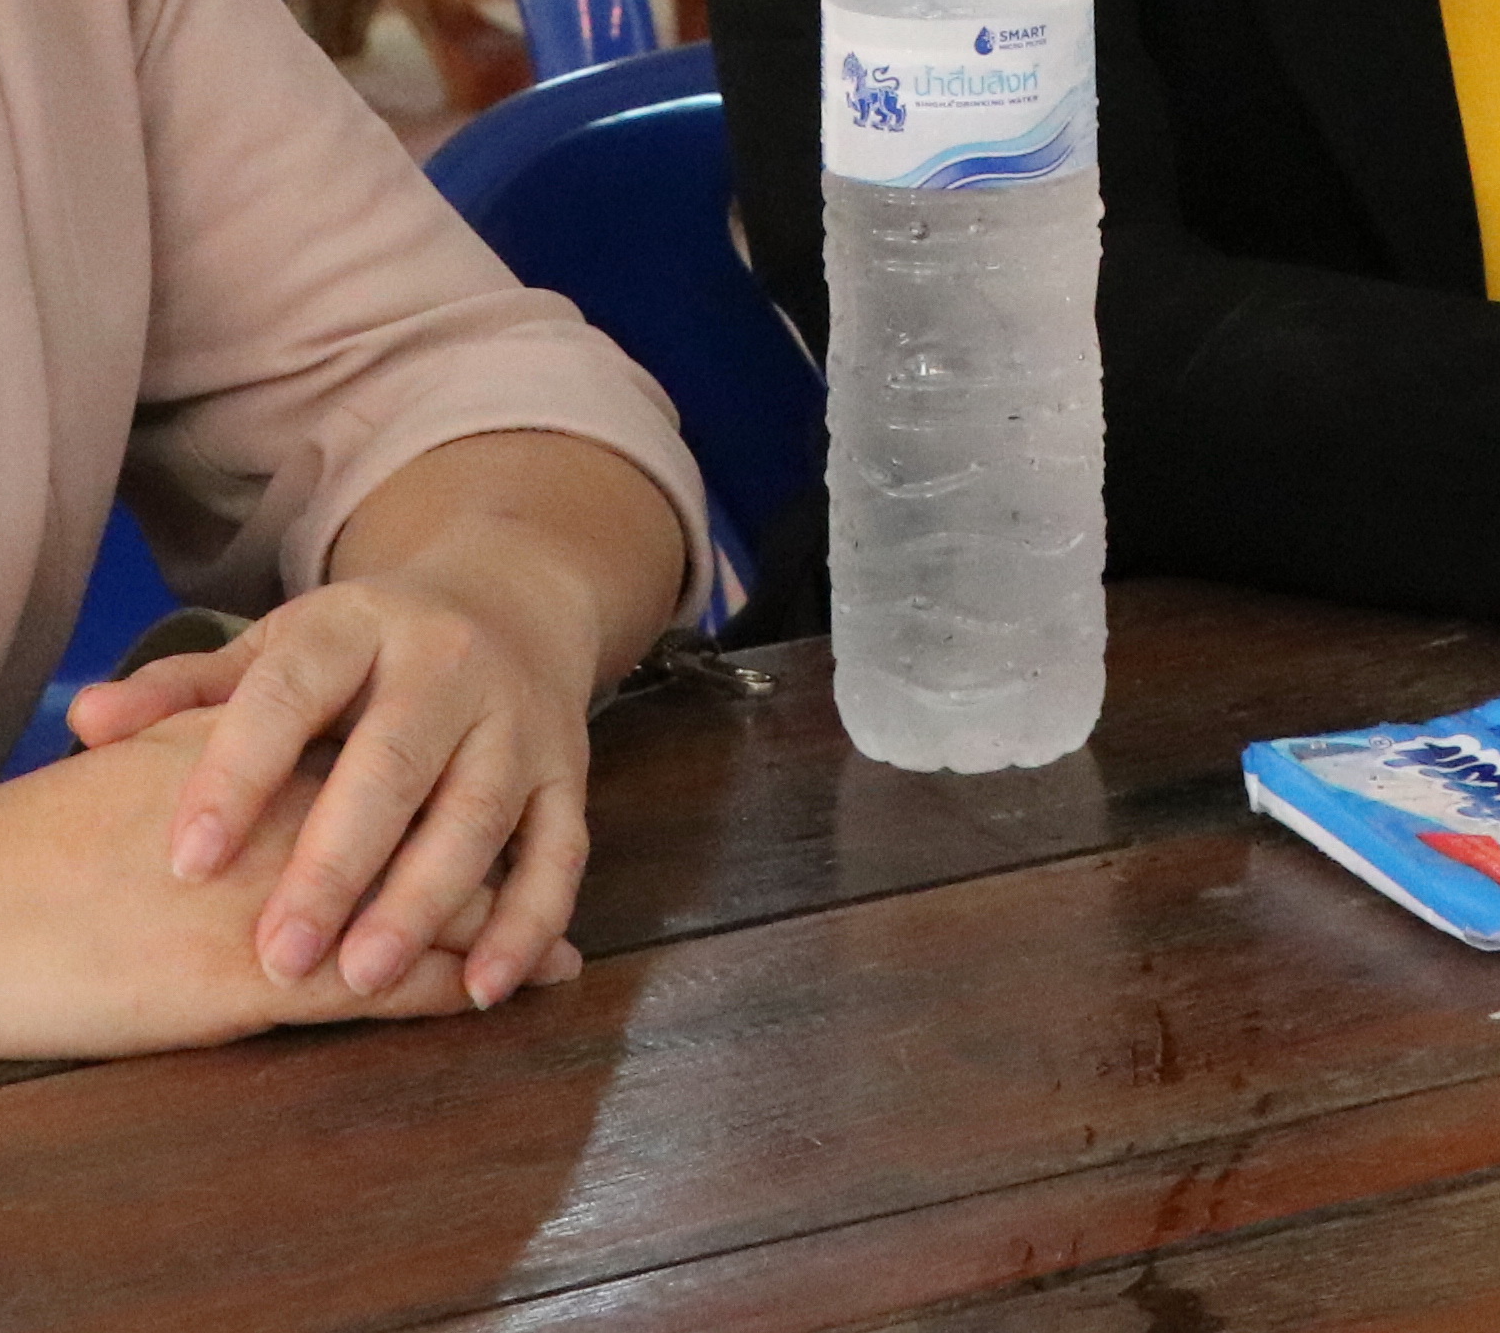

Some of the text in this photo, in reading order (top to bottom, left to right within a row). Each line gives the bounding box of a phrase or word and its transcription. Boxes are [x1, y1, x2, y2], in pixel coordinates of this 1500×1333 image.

[999, 24, 1047, 42] SMART
[914, 63, 1040, 97] น้ำดื่มสิงห์
[1008, 95, 1039, 104] WATER
